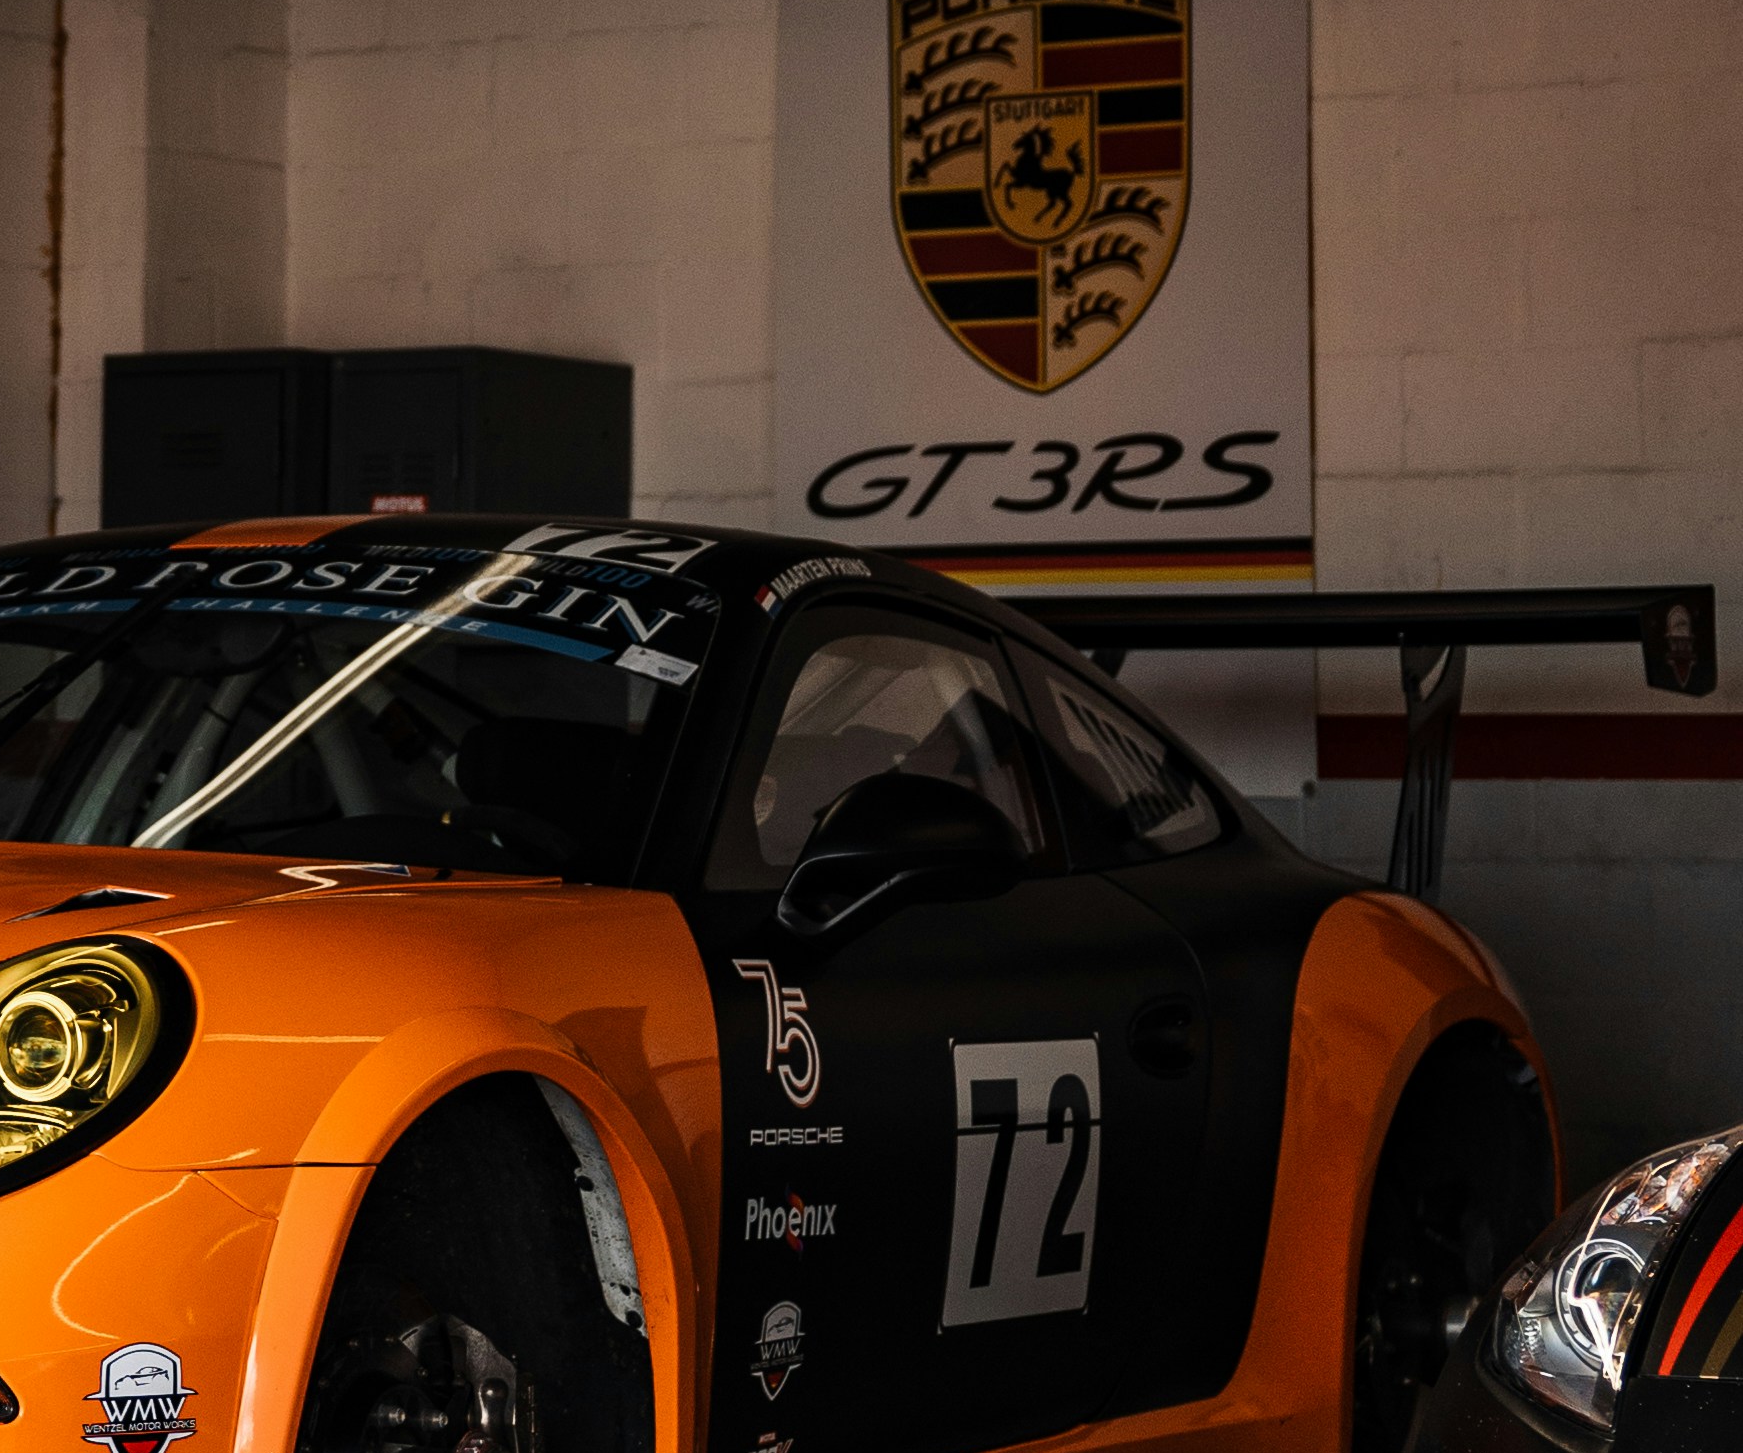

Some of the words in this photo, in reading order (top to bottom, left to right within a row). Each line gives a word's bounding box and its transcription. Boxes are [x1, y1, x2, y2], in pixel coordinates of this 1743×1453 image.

[994, 99, 1085, 124] STUTTGART
[524, 525, 705, 572] 72
[462, 575, 686, 645] GIN
[731, 958, 823, 1109] 75
[750, 1126, 844, 1146] PORSCHE
[969, 1073, 1092, 1289] 72
[744, 1197, 838, 1241] Phoenix
[759, 1337, 802, 1361] WMW
[84, 1423, 127, 1435] WENTZEL
[128, 1421, 162, 1433] MOTOR
[163, 1418, 197, 1430] WORKS
[102, 1396, 186, 1423] WMW
